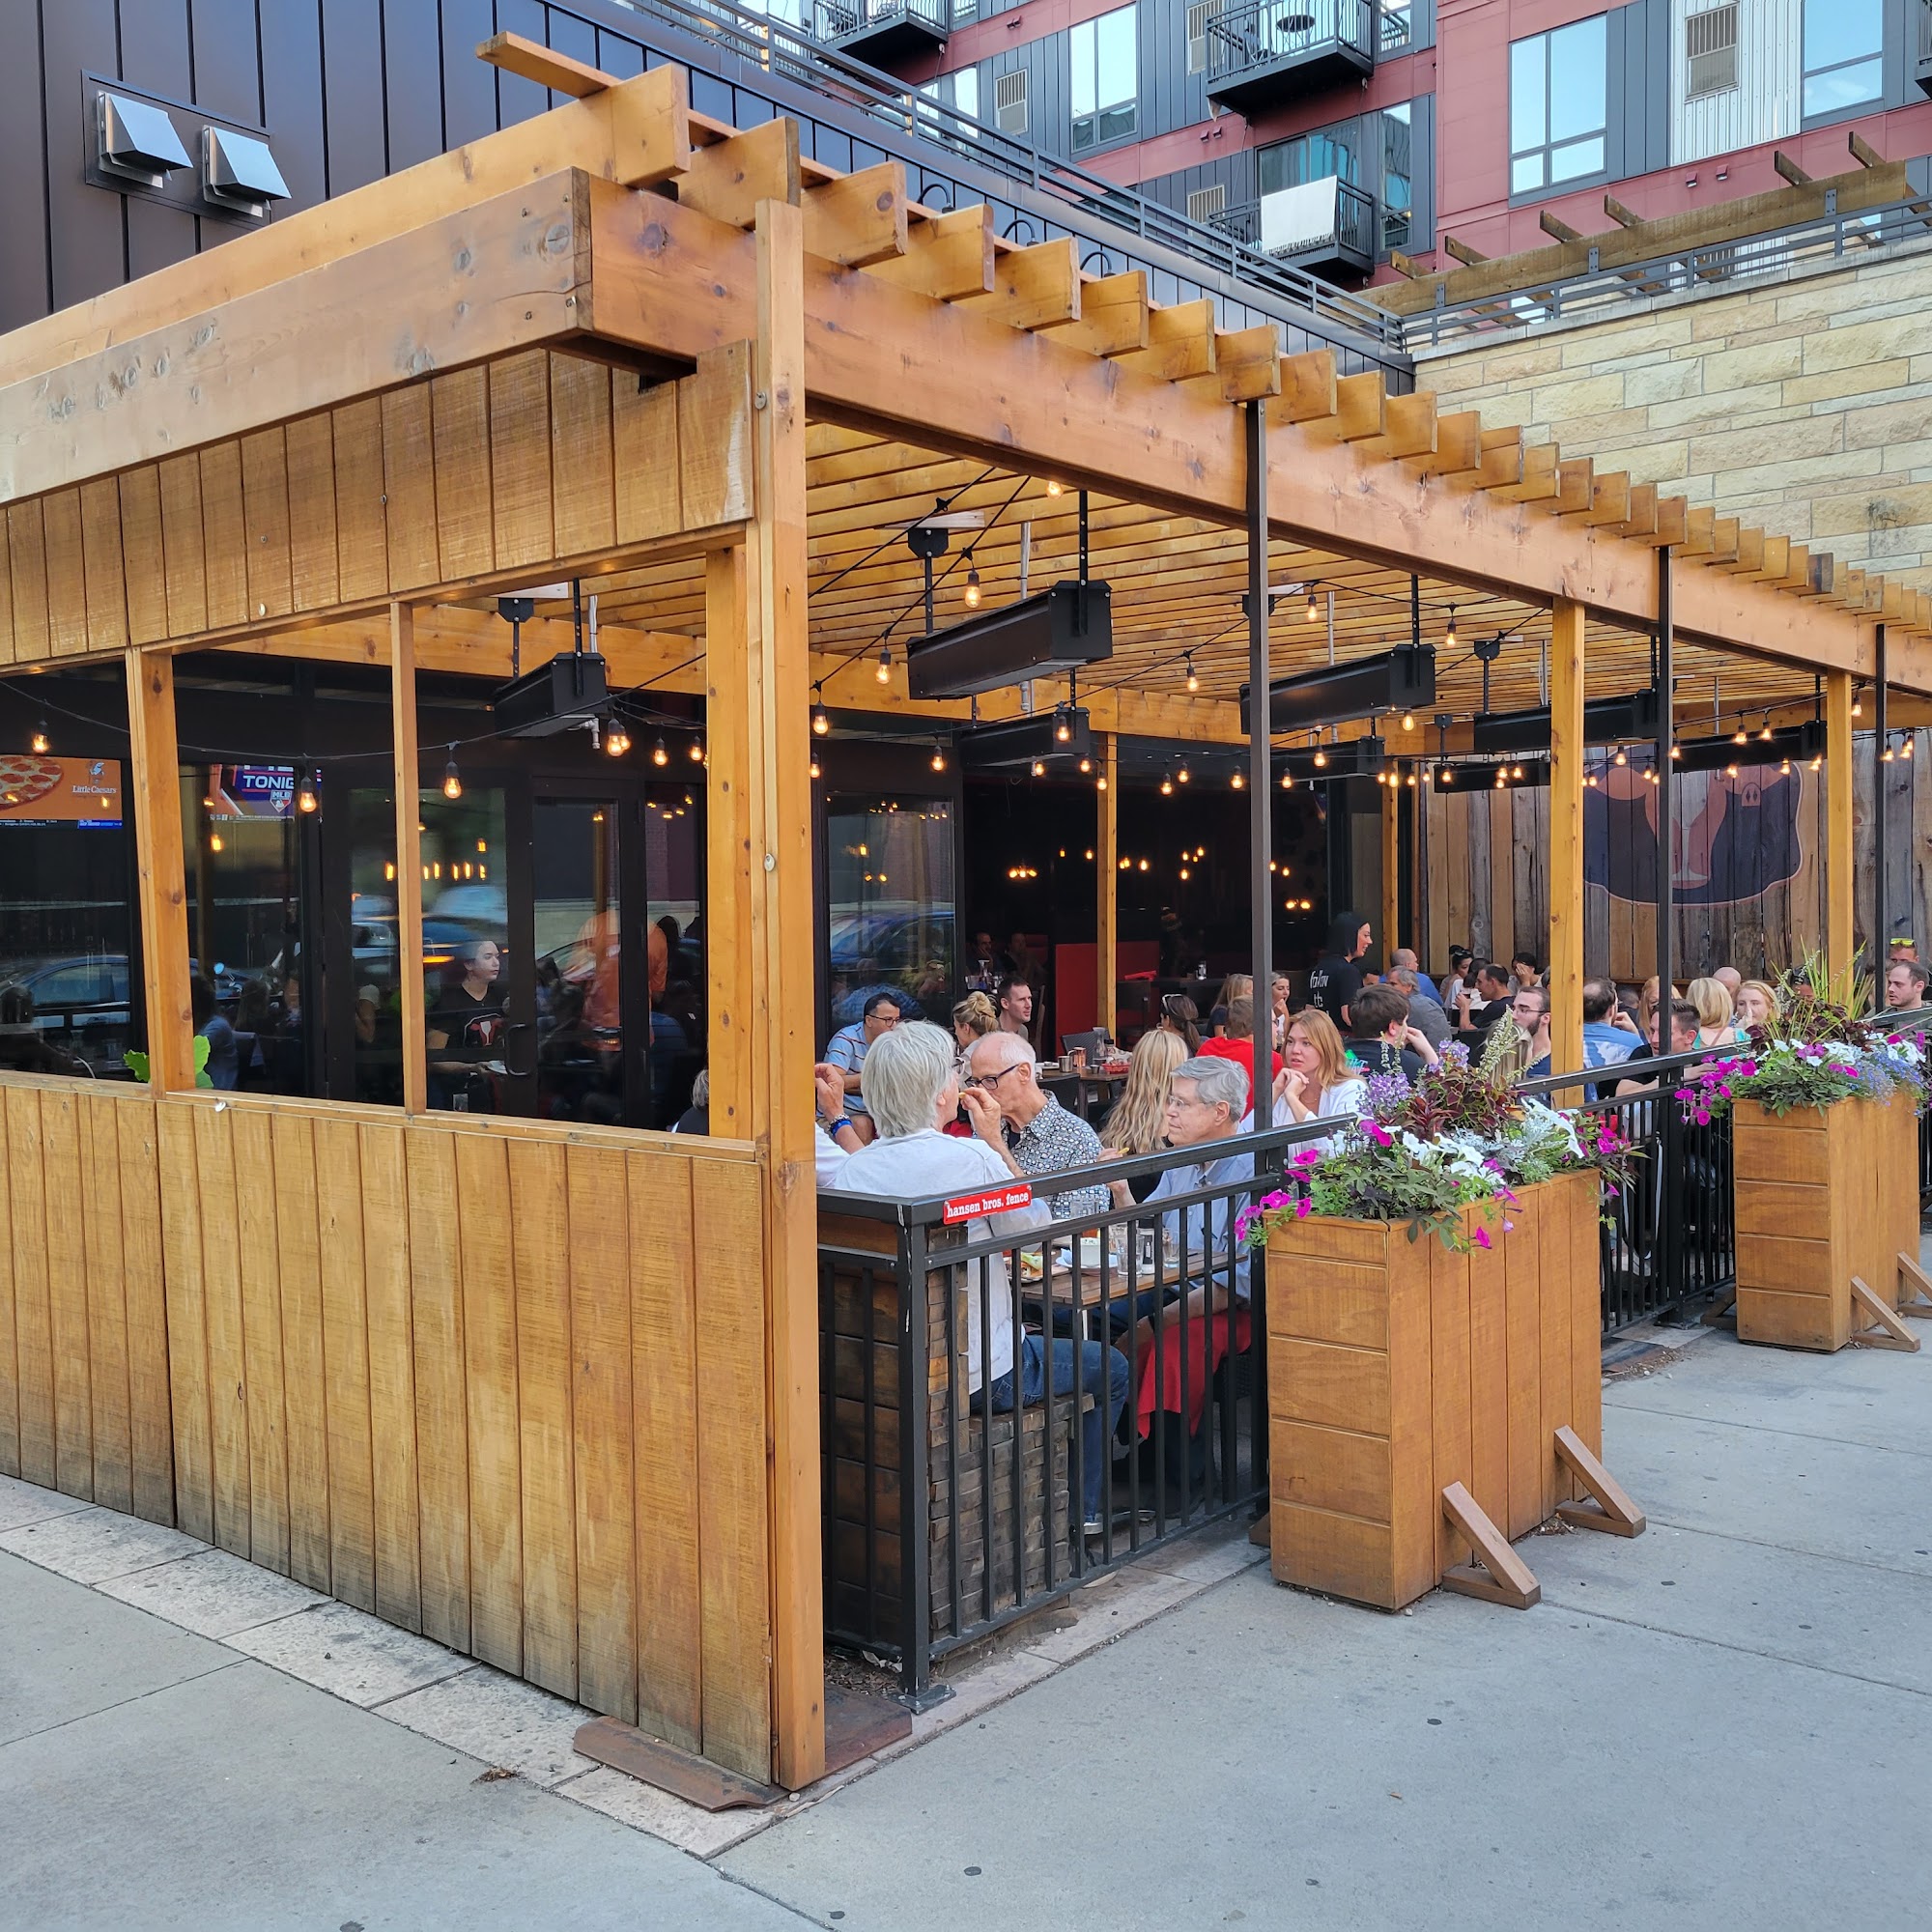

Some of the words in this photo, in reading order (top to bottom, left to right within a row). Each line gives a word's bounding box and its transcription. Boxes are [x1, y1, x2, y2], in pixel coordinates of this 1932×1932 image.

[243, 775, 294, 789] TONIG
[947, 1203, 980, 1218] hansen
[981, 1198, 1005, 1210] bros.
[1006, 1192, 1029, 1207] fence
